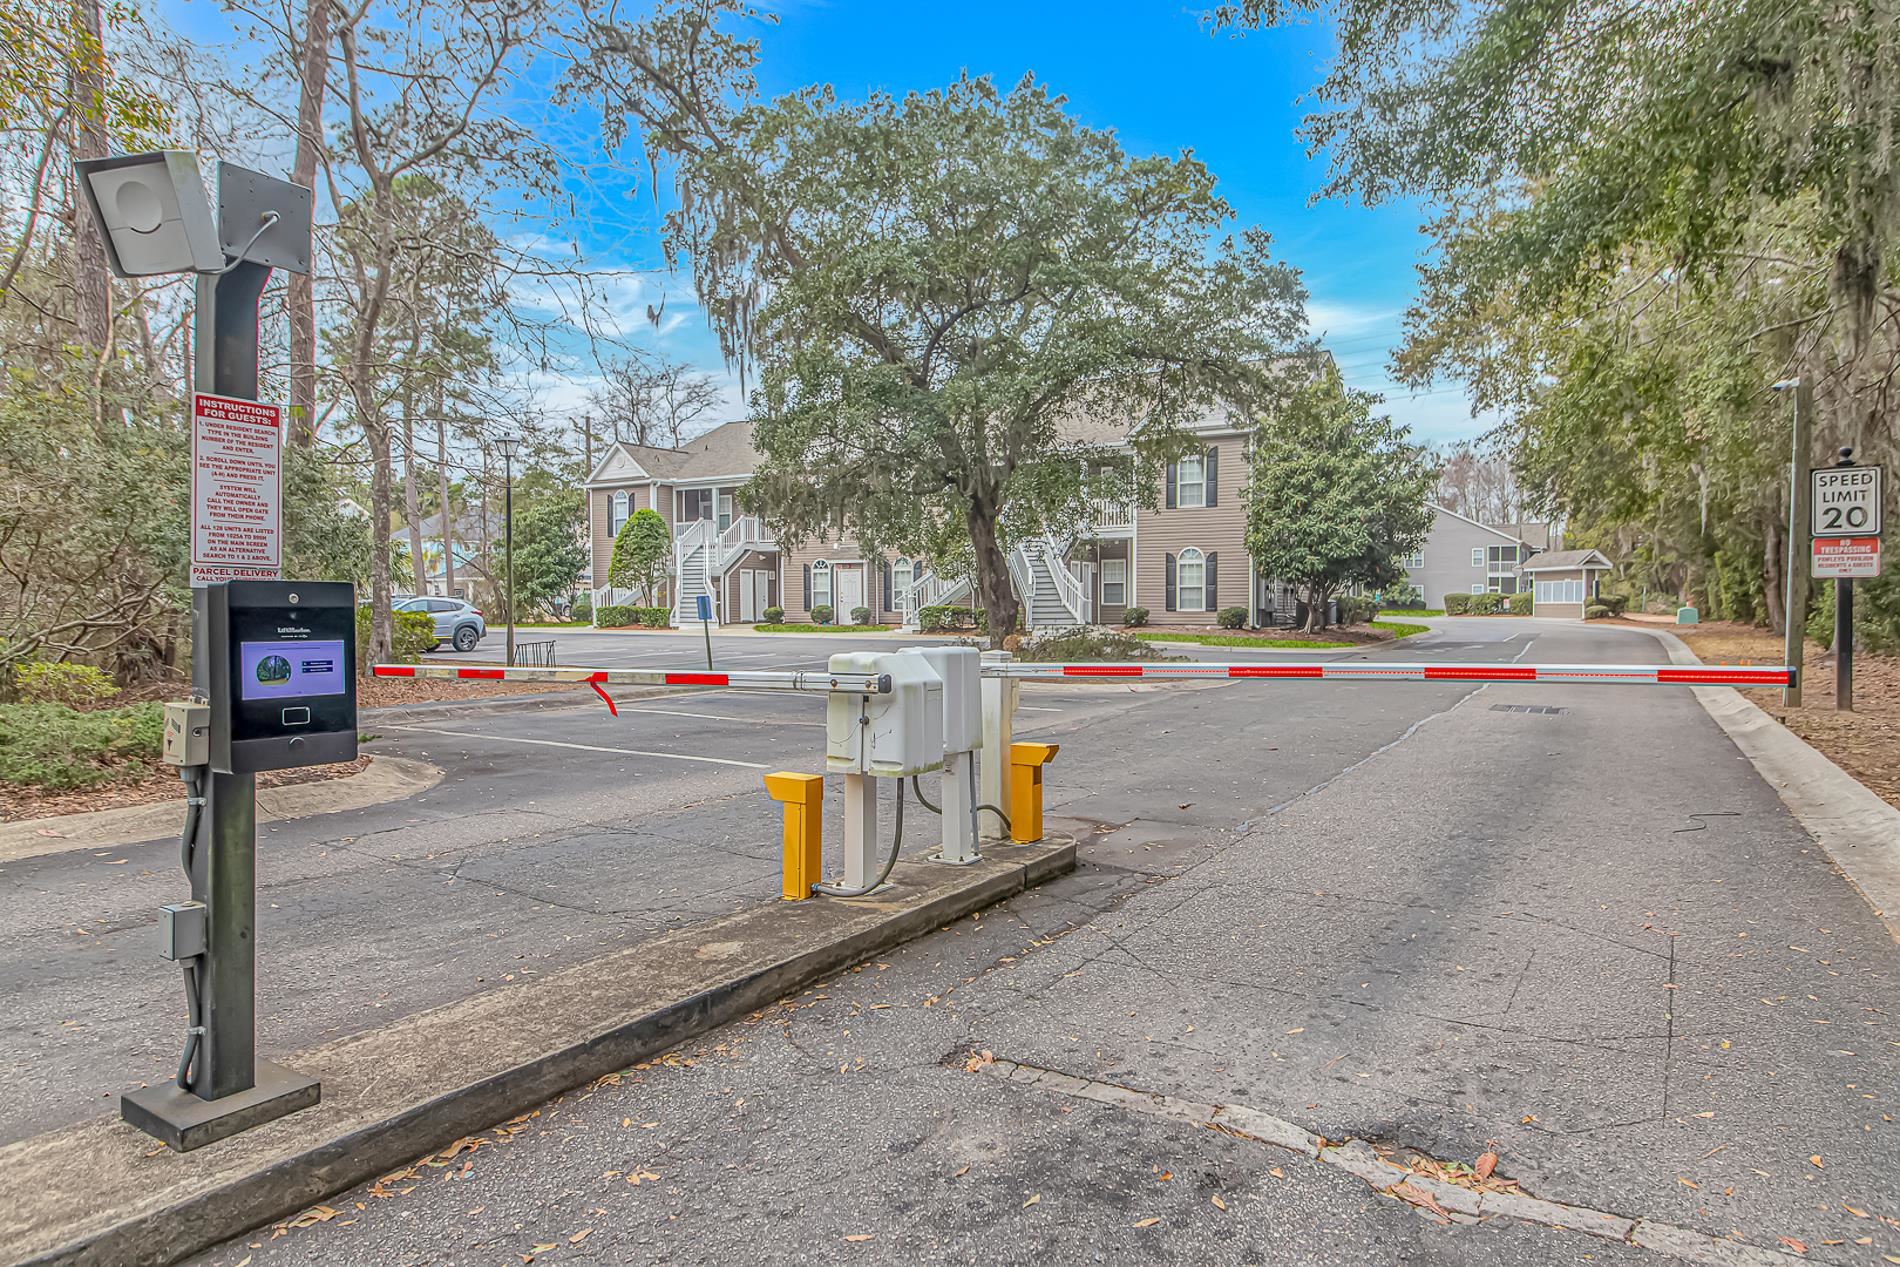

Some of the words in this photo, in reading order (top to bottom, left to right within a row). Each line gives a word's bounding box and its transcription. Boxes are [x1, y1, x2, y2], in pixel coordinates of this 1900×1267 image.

[200, 398, 276, 417] INSTRUCTIONS
[204, 409, 225, 418] FOR
[228, 412, 271, 425] GUESTS:
[226, 424, 252, 433] RESIDENT
[243, 432, 268, 442] BUILDING
[248, 440, 273, 449] RESIDENT
[224, 465, 261, 474] APPROPRIATE
[1819, 474, 1872, 487] SPEED
[215, 491, 261, 500] AUTOMATICALLY
[1823, 490, 1868, 503] LIMIT
[1822, 506, 1868, 529] 20
[1821, 545, 1872, 555] TRESPASSING
[234, 569, 278, 577] DELIVERY
